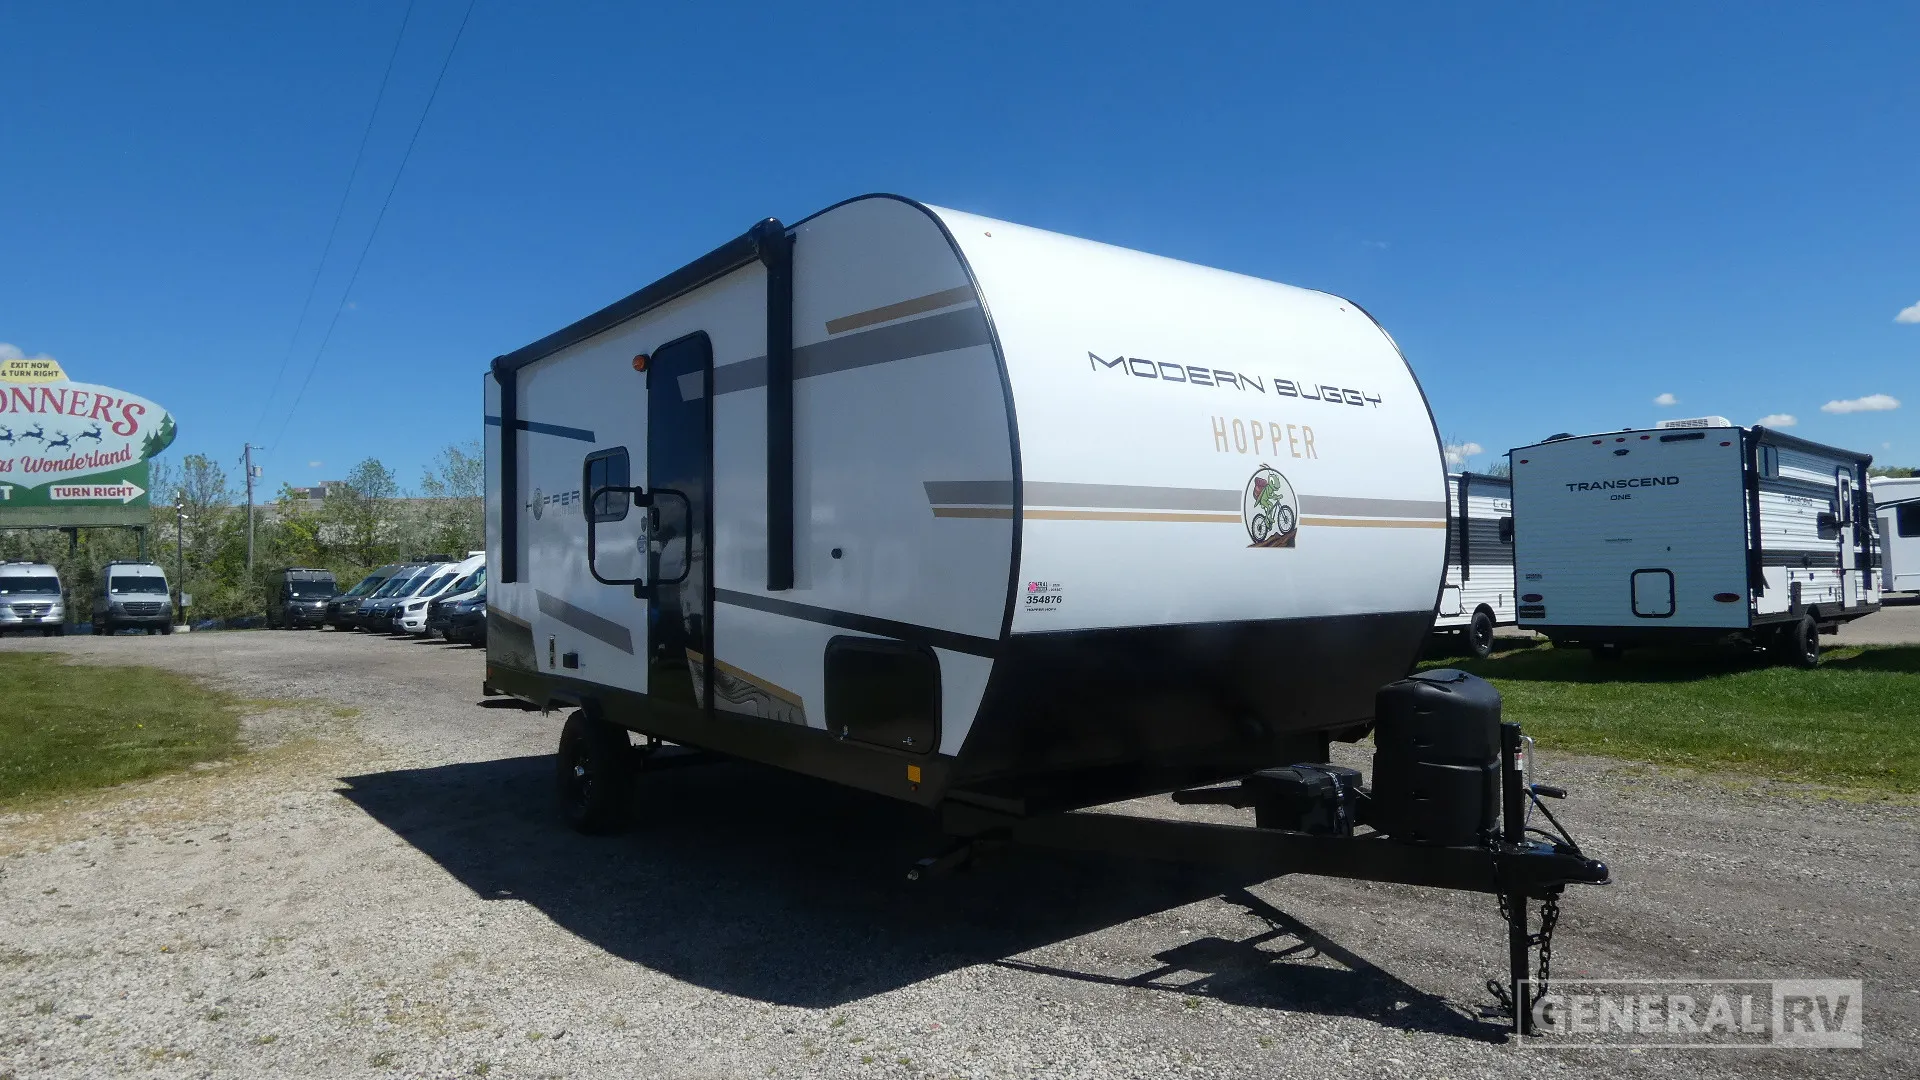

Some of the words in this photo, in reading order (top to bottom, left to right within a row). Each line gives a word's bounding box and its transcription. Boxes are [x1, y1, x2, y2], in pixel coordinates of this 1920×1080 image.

[1088, 351, 1265, 394] MODERN
[1274, 378, 1382, 408] BUGGY
[1211, 415, 1318, 460] HOPPER
[21, 443, 132, 473] Wonderland
[54, 487, 91, 497] TURN
[94, 486, 135, 497] RIGHT
[1566, 475, 1680, 492] TRANSCEND
[1610, 493, 1632, 501] ONE
[1026, 595, 1062, 604] 354876
